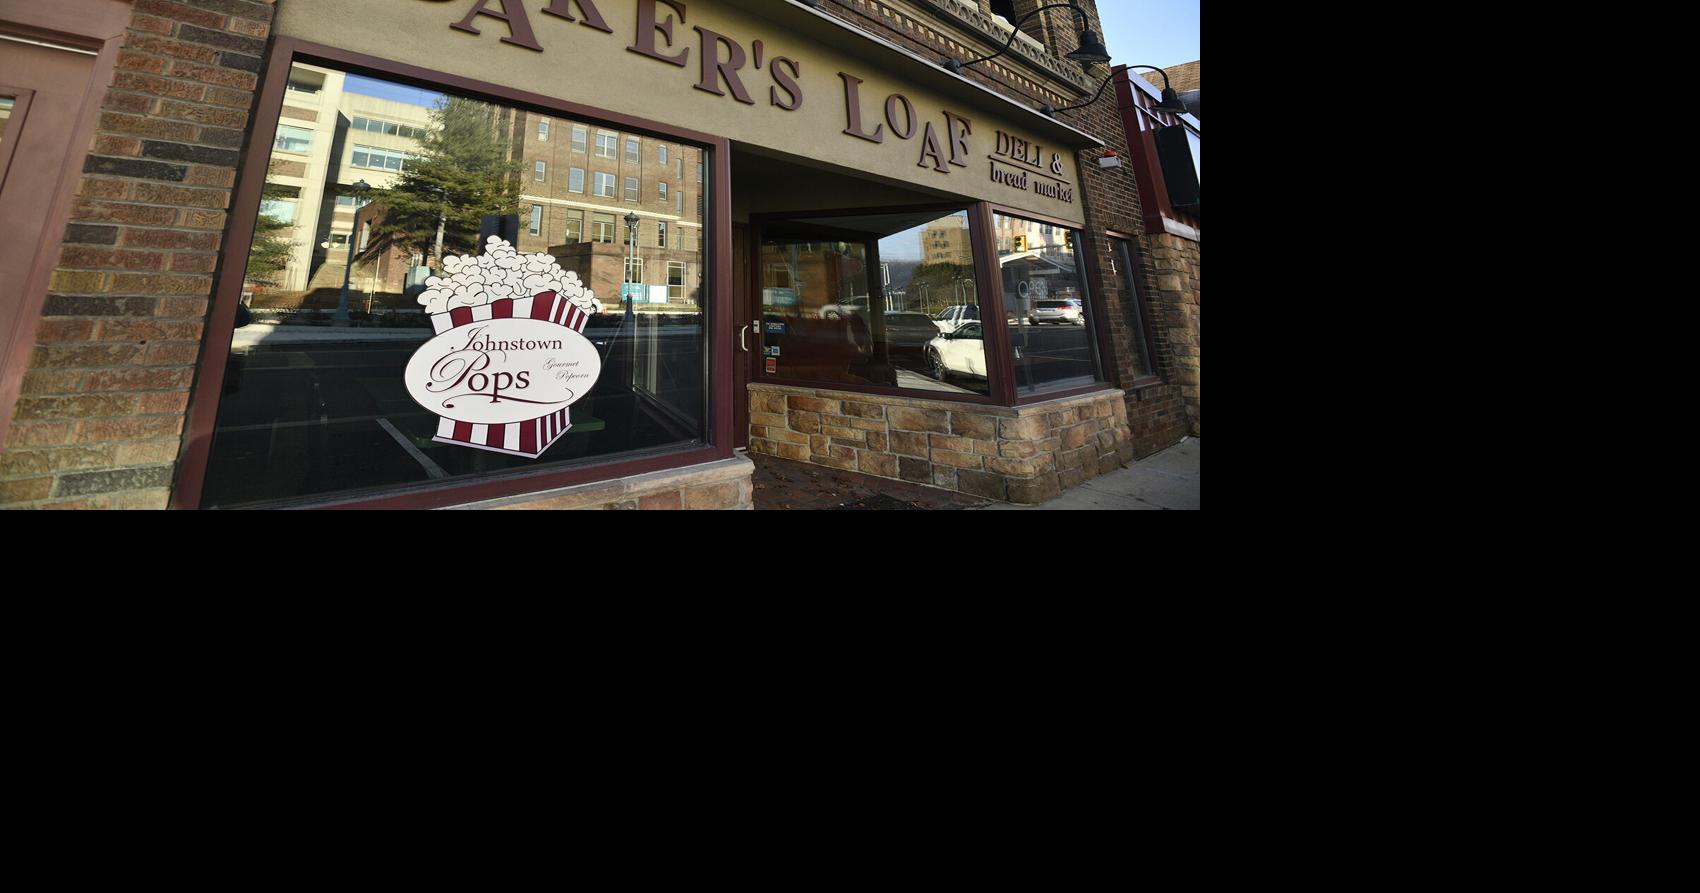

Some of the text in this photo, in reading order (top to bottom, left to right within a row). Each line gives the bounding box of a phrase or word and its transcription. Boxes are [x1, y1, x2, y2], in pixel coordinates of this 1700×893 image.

[837, 72, 972, 173] LOAF
[995, 130, 1063, 176] DELI &
[990, 160, 1073, 203] bread market
[451, 325, 562, 351] Johnstown
[425, 350, 530, 404] Pops
[543, 358, 580, 370] Gourmet
[555, 370, 589, 382] Popcorn
